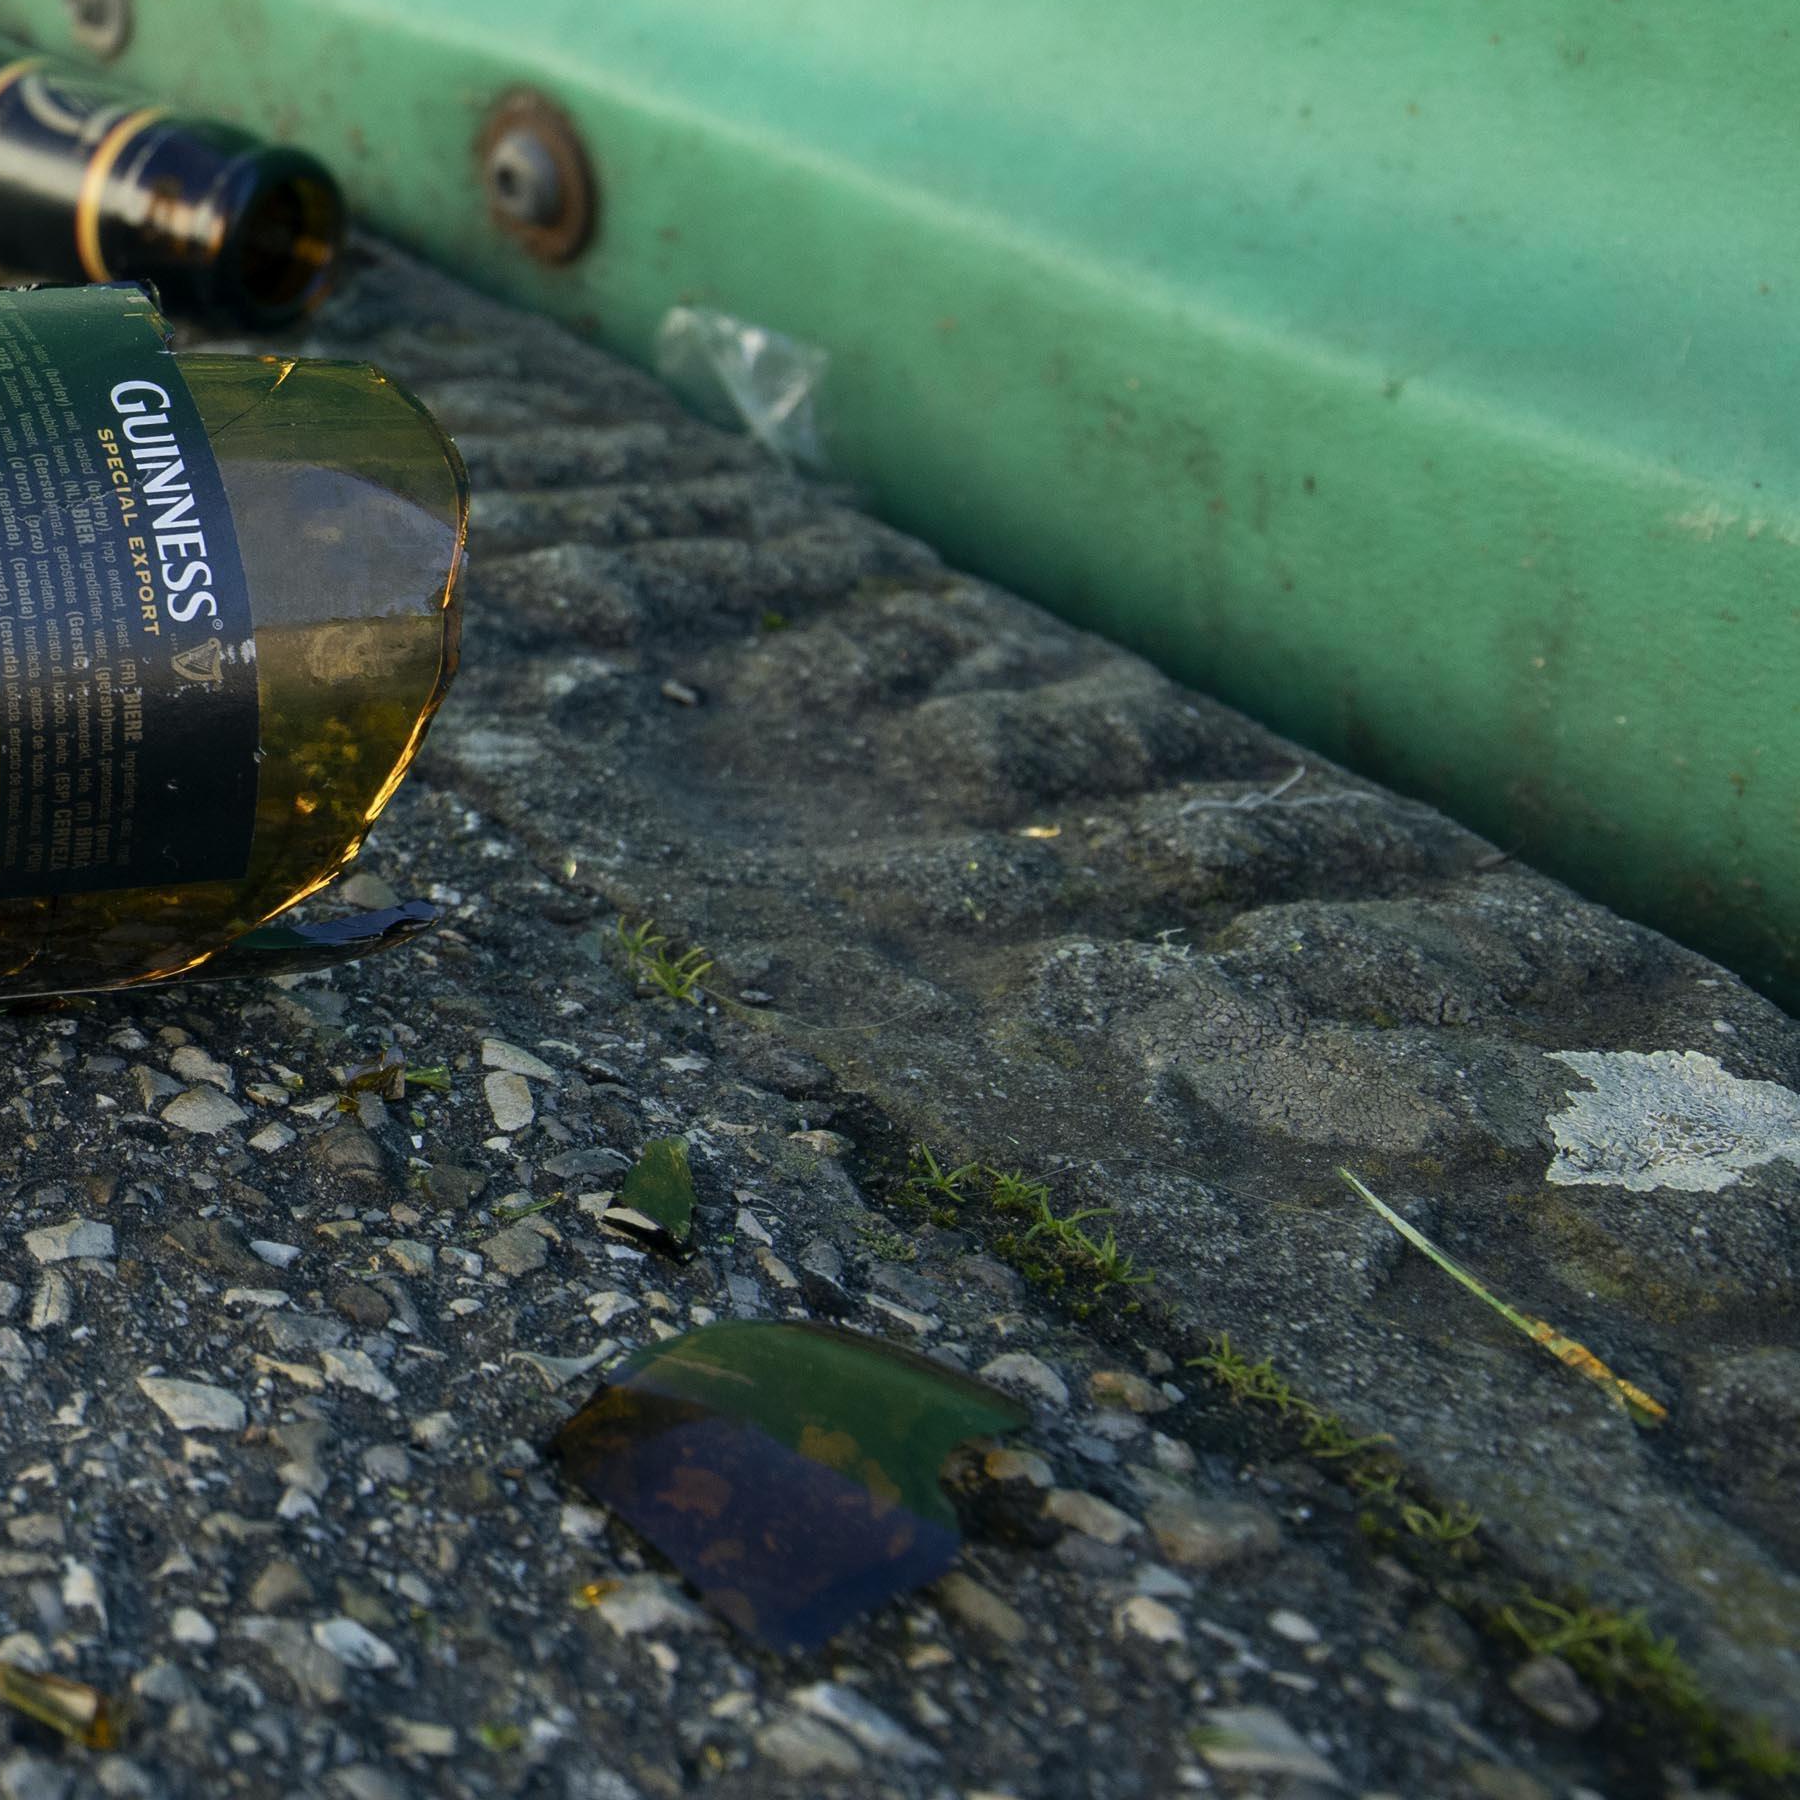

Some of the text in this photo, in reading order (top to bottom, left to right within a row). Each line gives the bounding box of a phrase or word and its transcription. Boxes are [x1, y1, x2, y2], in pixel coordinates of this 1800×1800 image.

[17, 411, 77, 604] Wasser, geröstetes
[31, 390, 59, 441] de houblon,
[41, 367, 131, 652] (barley) roasted hop extract, yeast.
[111, 378, 215, 623] GUINNESS
[97, 427, 159, 638] SPECIAL EXPORT
[0, 426, 72, 871] malto (d'orzo), (orzo) torrefatto, estratto (ESP) CERVEZA
[9, 556, 36, 620] (cebada)
[32, 734, 46, 750] de
